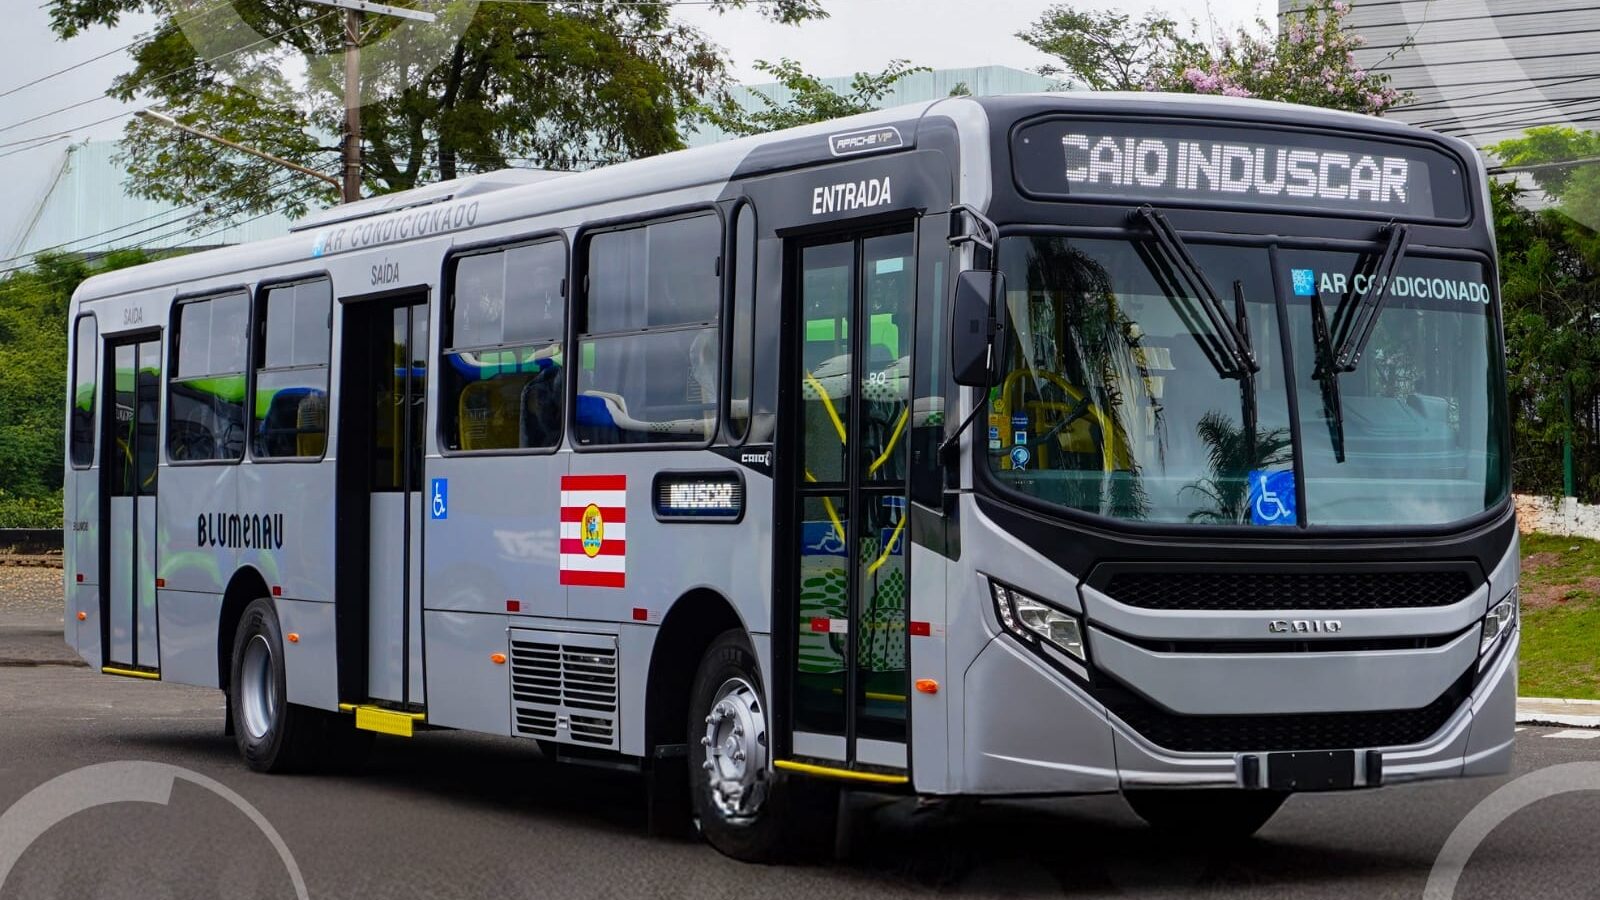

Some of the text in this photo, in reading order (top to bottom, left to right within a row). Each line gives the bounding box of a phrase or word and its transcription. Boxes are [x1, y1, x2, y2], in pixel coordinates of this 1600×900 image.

[837, 134, 876, 149] APACHE
[1062, 134, 1408, 203] CAIO INDUSCAR
[812, 176, 891, 215] ENTRADA
[323, 200, 479, 251] AR CONDICIONADO
[371, 257, 399, 286] SAÍDA
[1319, 272, 1348, 293] AR
[741, 453, 765, 463] CAIO
[1268, 620, 1342, 633] CAIO
